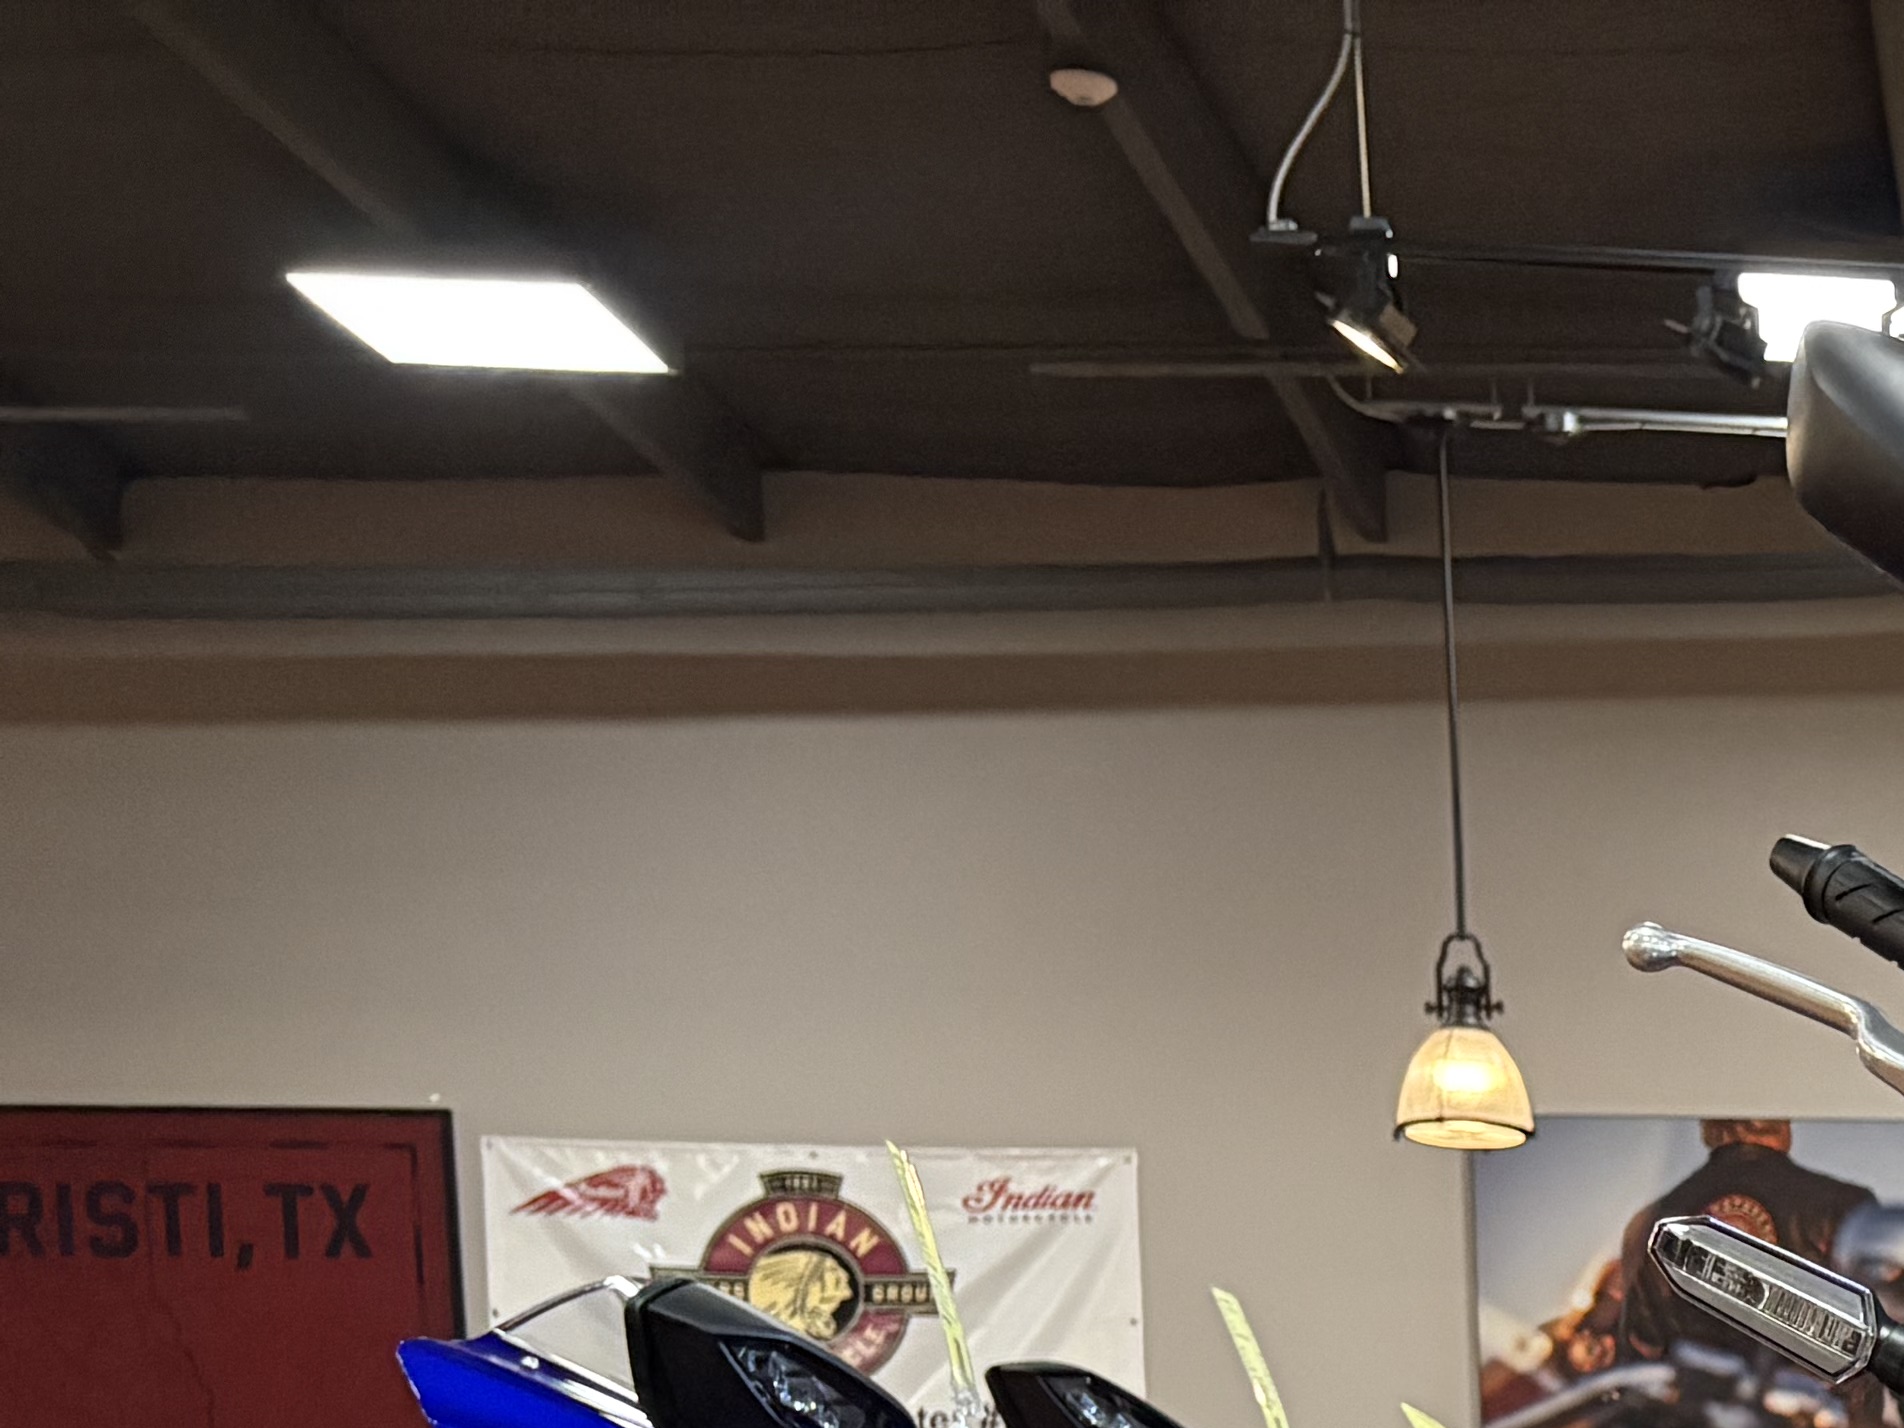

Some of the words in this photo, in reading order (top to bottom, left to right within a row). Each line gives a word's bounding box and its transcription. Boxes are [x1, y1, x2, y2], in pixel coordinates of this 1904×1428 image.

[961, 1176, 1096, 1214] Indian
[264, 1183, 372, 1260] TX
[728, 1201, 880, 1258] INDIAN
[872, 1283, 928, 1306] GROU
